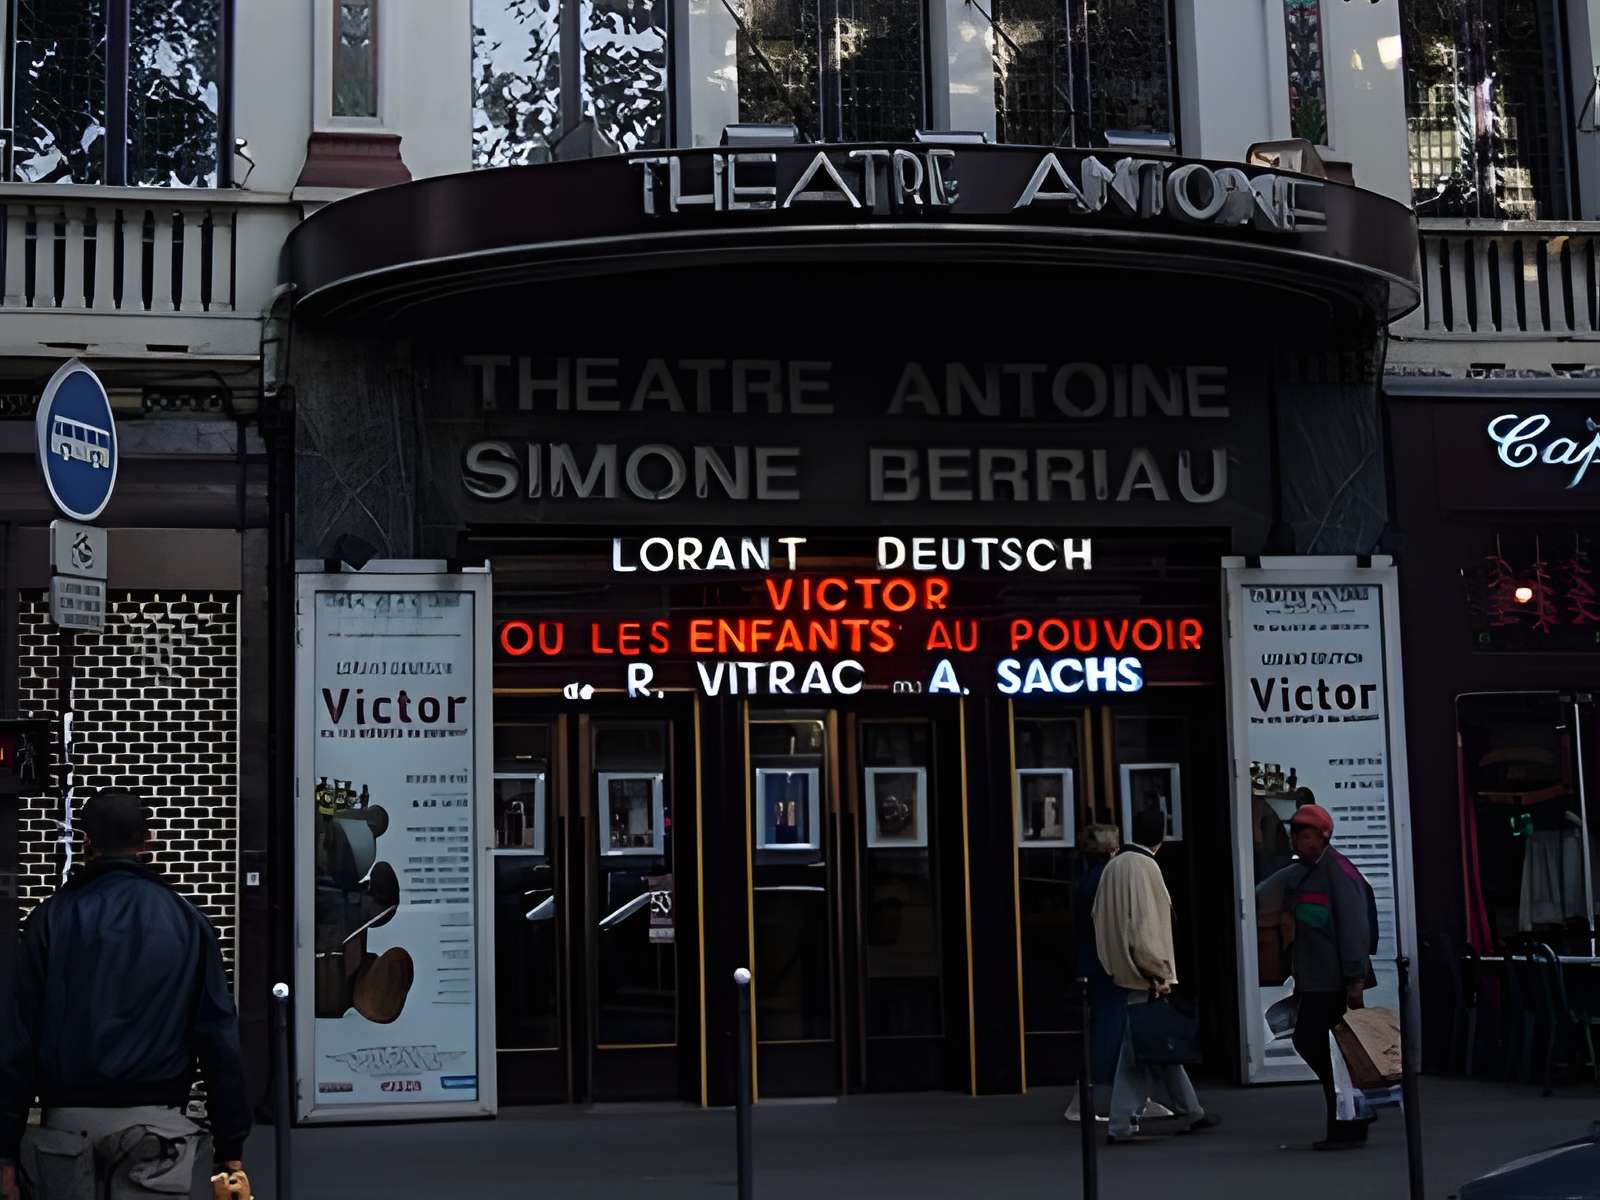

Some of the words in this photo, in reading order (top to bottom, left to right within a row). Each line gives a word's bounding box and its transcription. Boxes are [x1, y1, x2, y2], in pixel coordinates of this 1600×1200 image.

[628, 149, 960, 215] THEATRE
[464, 355, 834, 415] THEATRE
[887, 361, 1230, 418] ANTOINE
[463, 441, 800, 500] SIMONE
[870, 447, 1228, 503] BERRIAU
[612, 537, 807, 572] LORANT
[877, 536, 1092, 572] DEUTSCH
[766, 577, 949, 612] VICTOR
[500, 621, 564, 656] OU
[591, 620, 670, 655] LES
[690, 618, 896, 653] ENFANTS
[926, 619, 978, 652] AU
[1010, 618, 1203, 652] POUVOIR
[697, 660, 865, 696] VITRAC
[929, 659, 971, 696] A.
[997, 657, 1144, 695] SACHS
[1250, 677, 1377, 713] Victor
[321, 688, 468, 725] Victor
